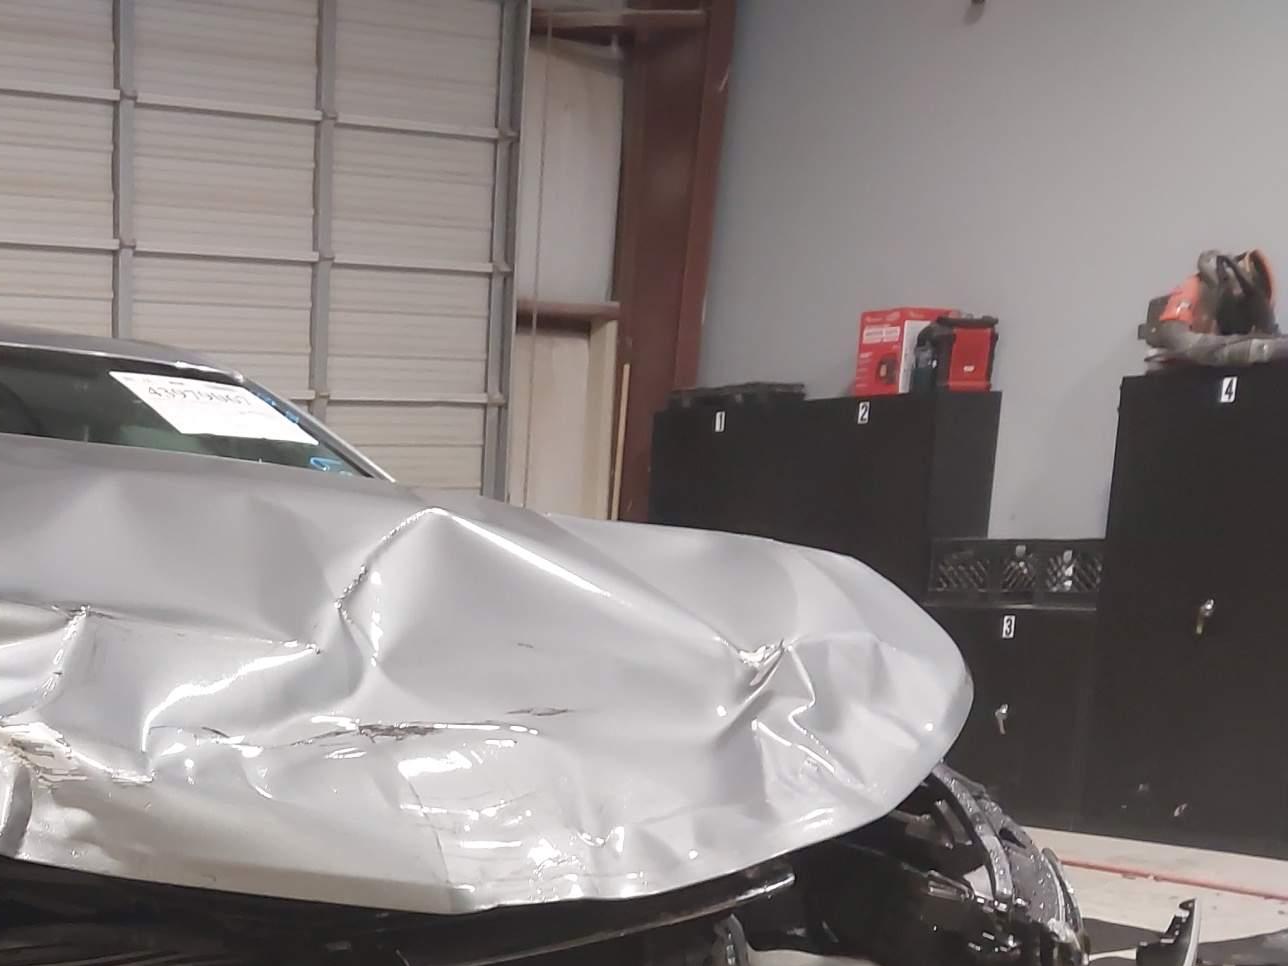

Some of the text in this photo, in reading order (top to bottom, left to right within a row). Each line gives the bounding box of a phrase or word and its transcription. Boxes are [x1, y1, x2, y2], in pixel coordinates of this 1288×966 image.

[1224, 379, 1235, 400] 4
[859, 404, 869, 422] 2
[1004, 617, 1013, 636] 3
